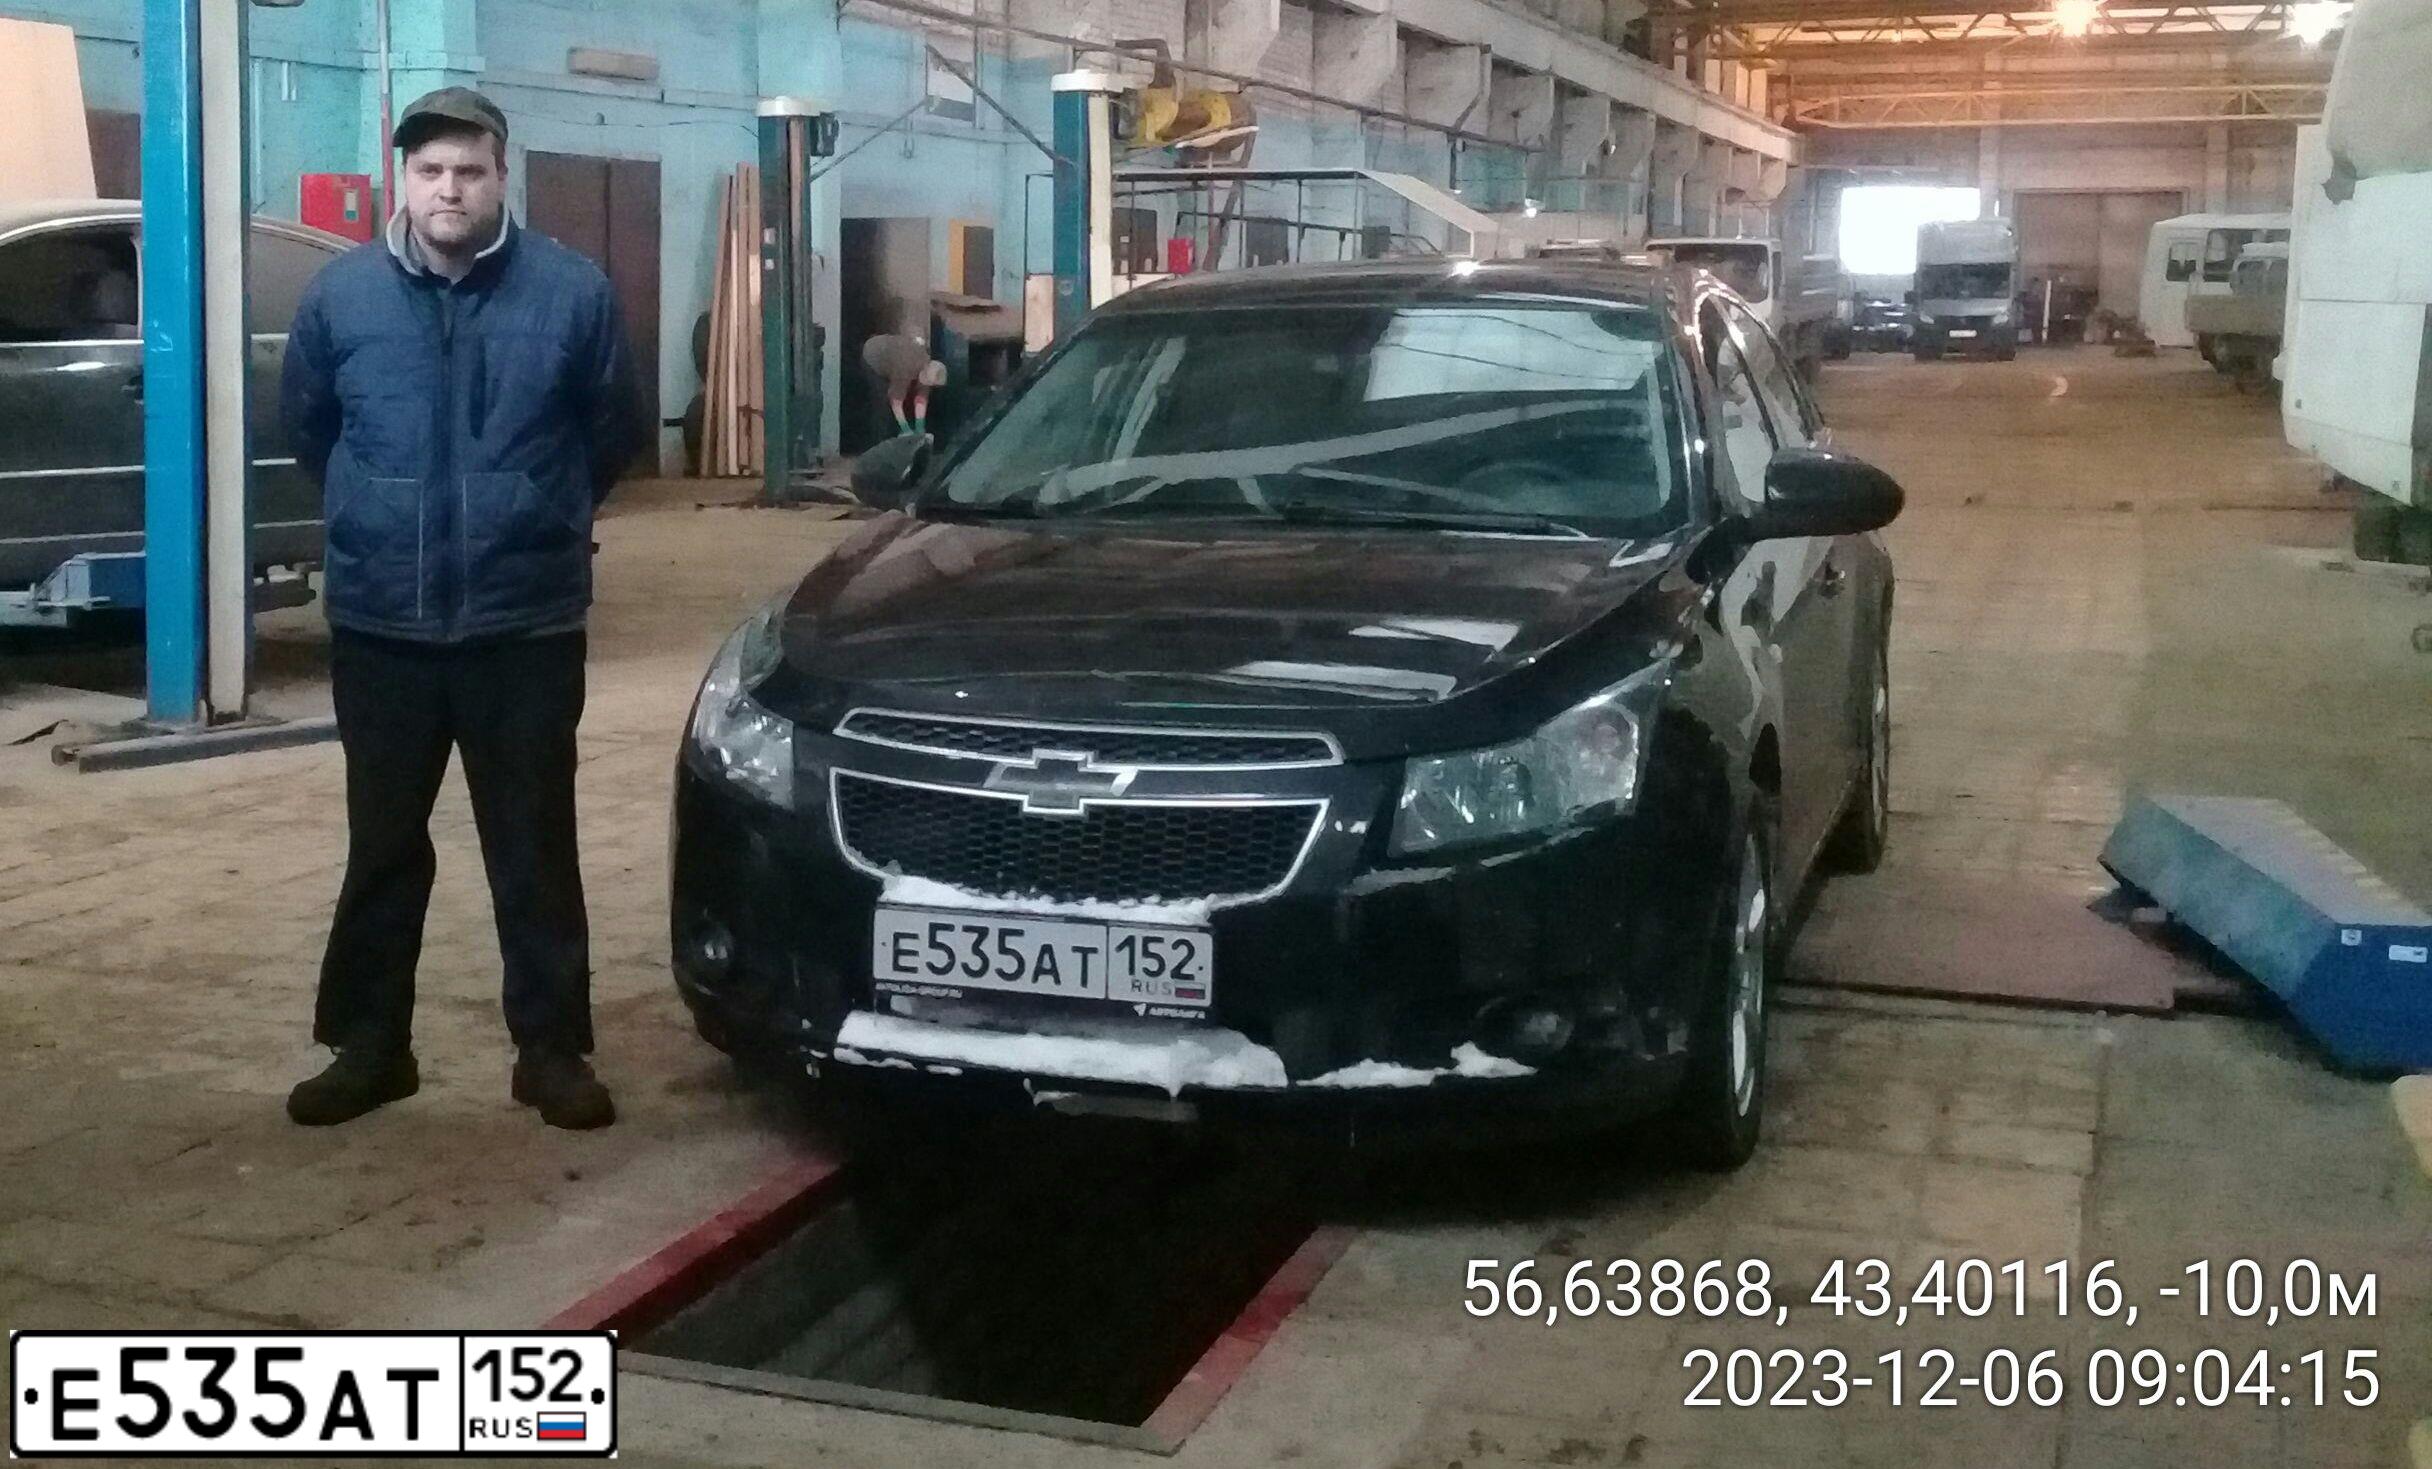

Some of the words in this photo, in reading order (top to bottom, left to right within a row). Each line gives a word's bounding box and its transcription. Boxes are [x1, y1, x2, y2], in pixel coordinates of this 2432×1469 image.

[892, 922, 1099, 988] Е535АТ
[1115, 934, 1197, 981] 152
[1131, 979, 1173, 996] RUS
